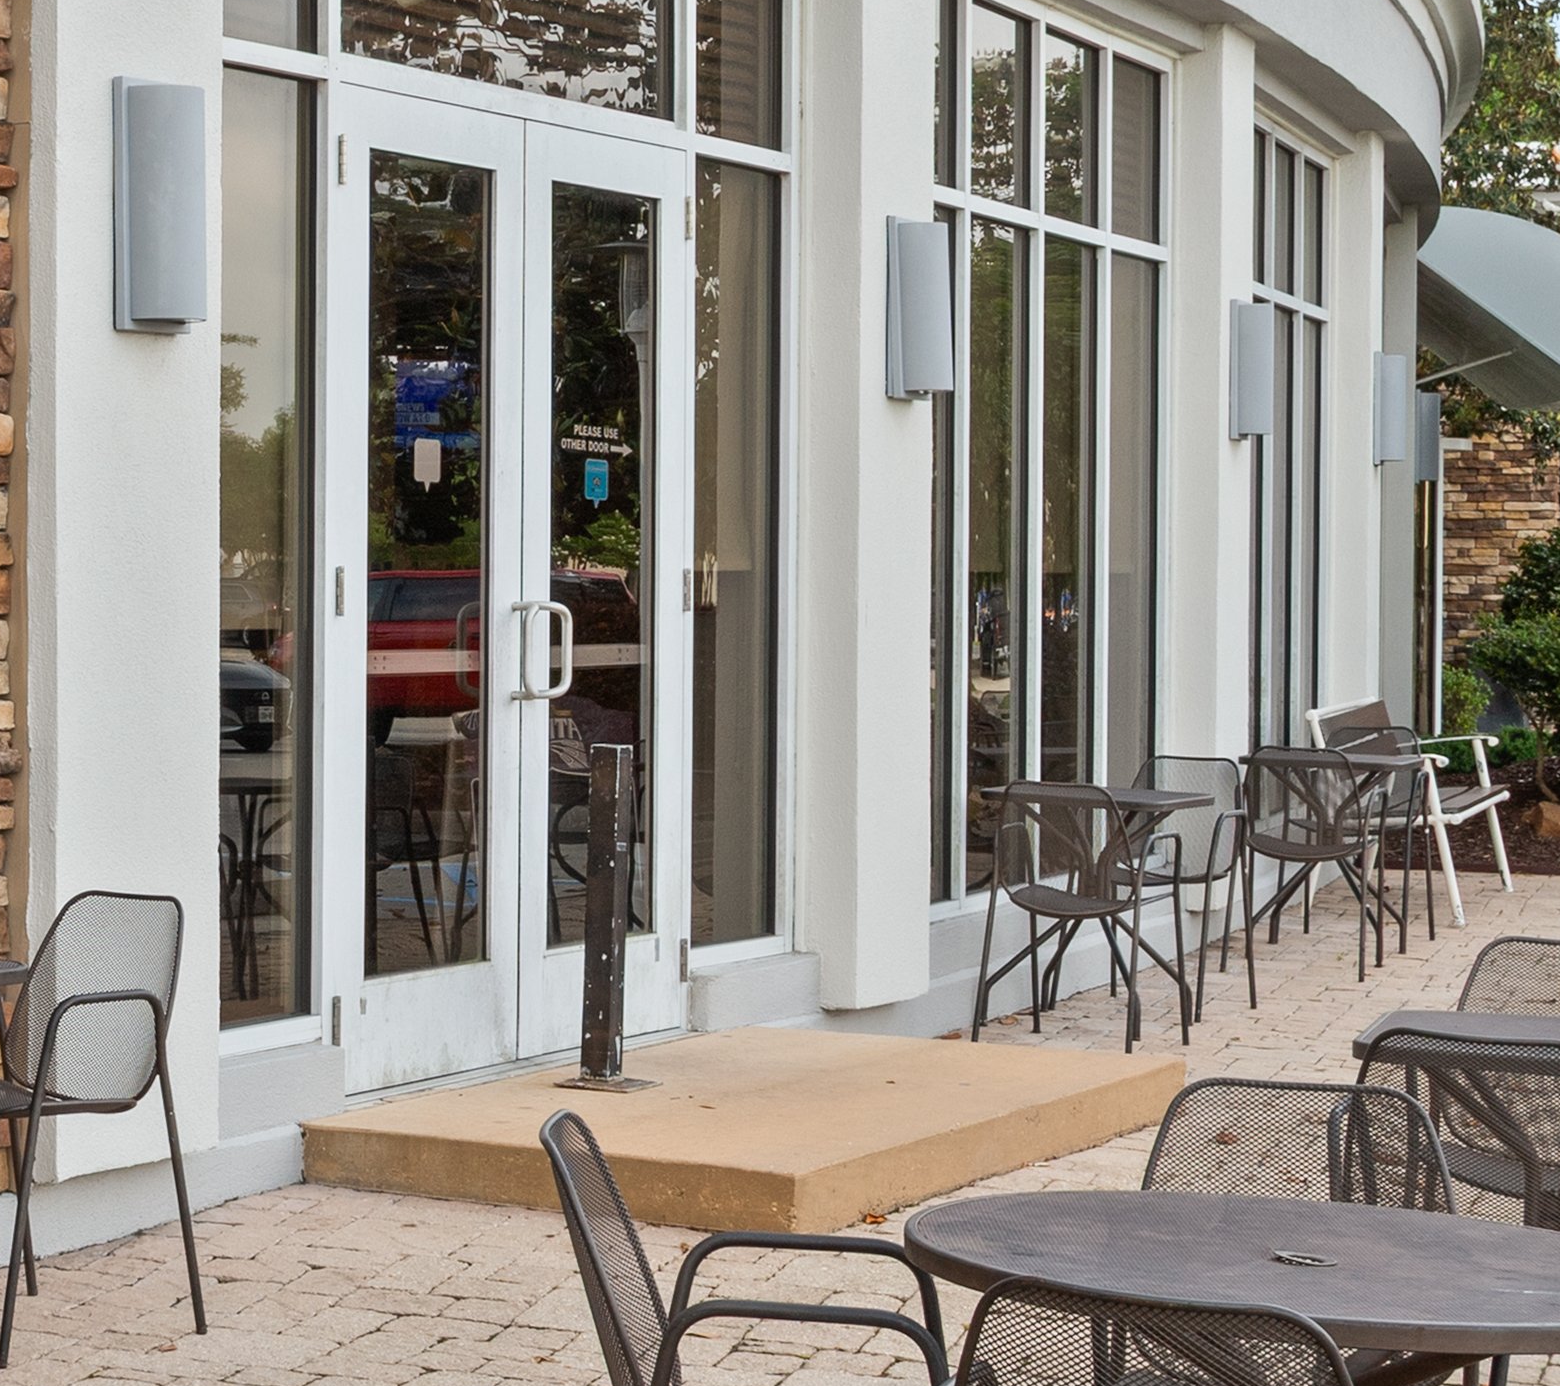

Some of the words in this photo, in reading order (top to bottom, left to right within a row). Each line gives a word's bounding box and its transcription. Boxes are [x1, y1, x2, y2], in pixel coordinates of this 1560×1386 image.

[573, 424, 602, 438] PLEASE
[603, 425, 619, 440] USE
[561, 438, 587, 451] OTHER
[588, 440, 609, 453] DOOR
